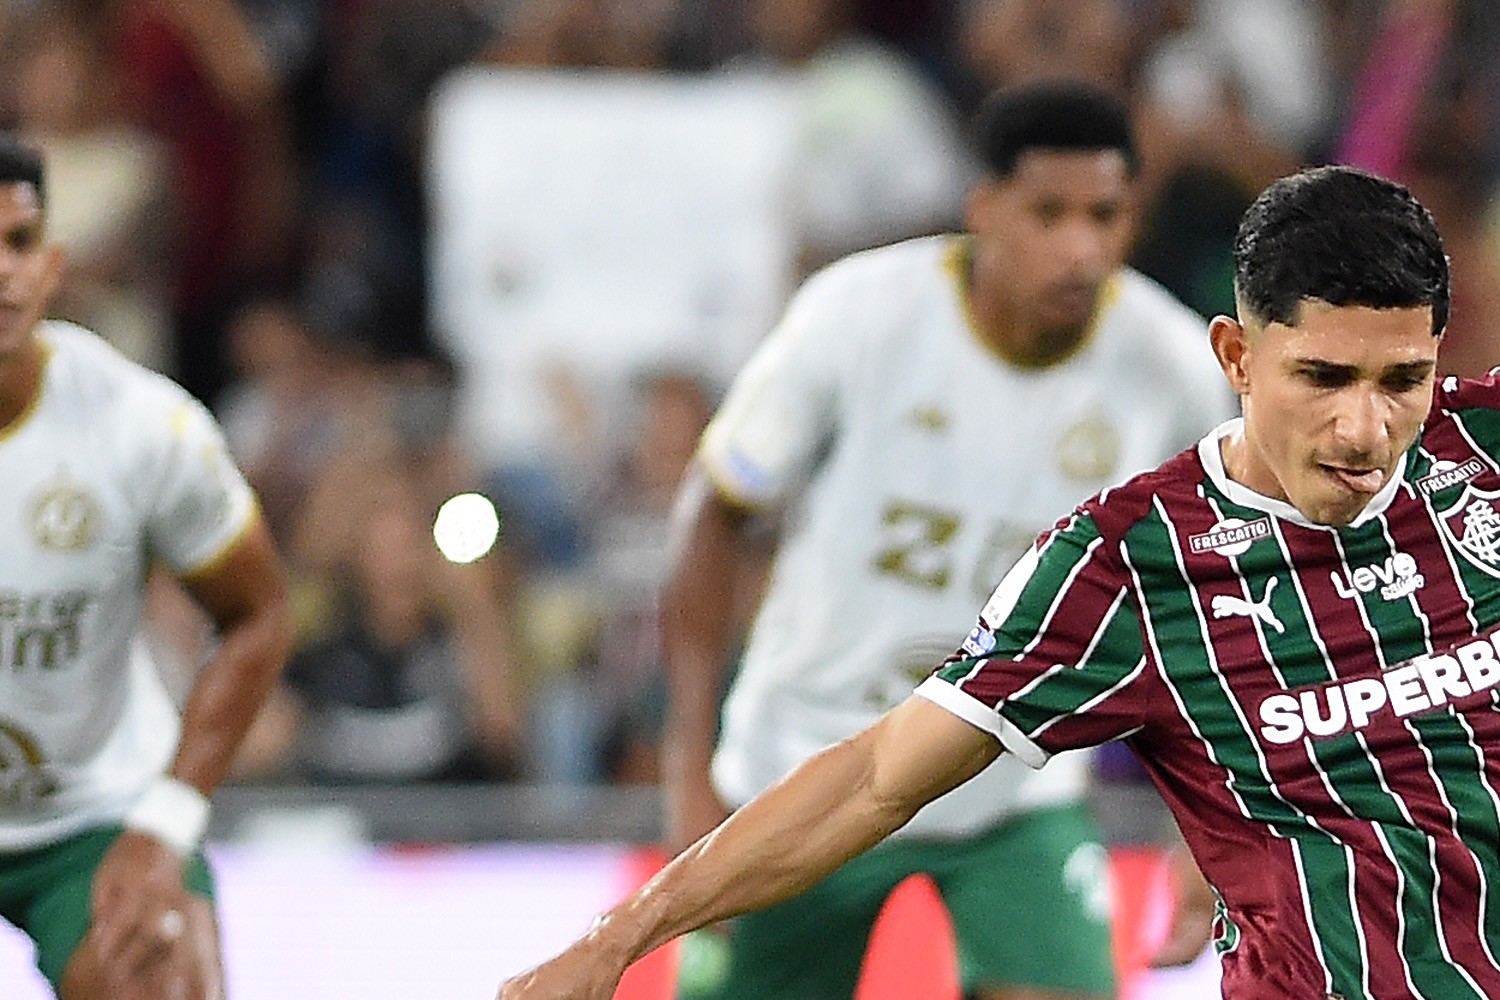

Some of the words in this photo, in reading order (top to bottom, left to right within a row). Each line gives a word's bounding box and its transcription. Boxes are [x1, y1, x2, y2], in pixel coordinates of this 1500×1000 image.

[1421, 461, 1482, 495] FRESCATTO
[1193, 521, 1267, 551] FRESCATTO
[1330, 552, 1418, 599] Leve
